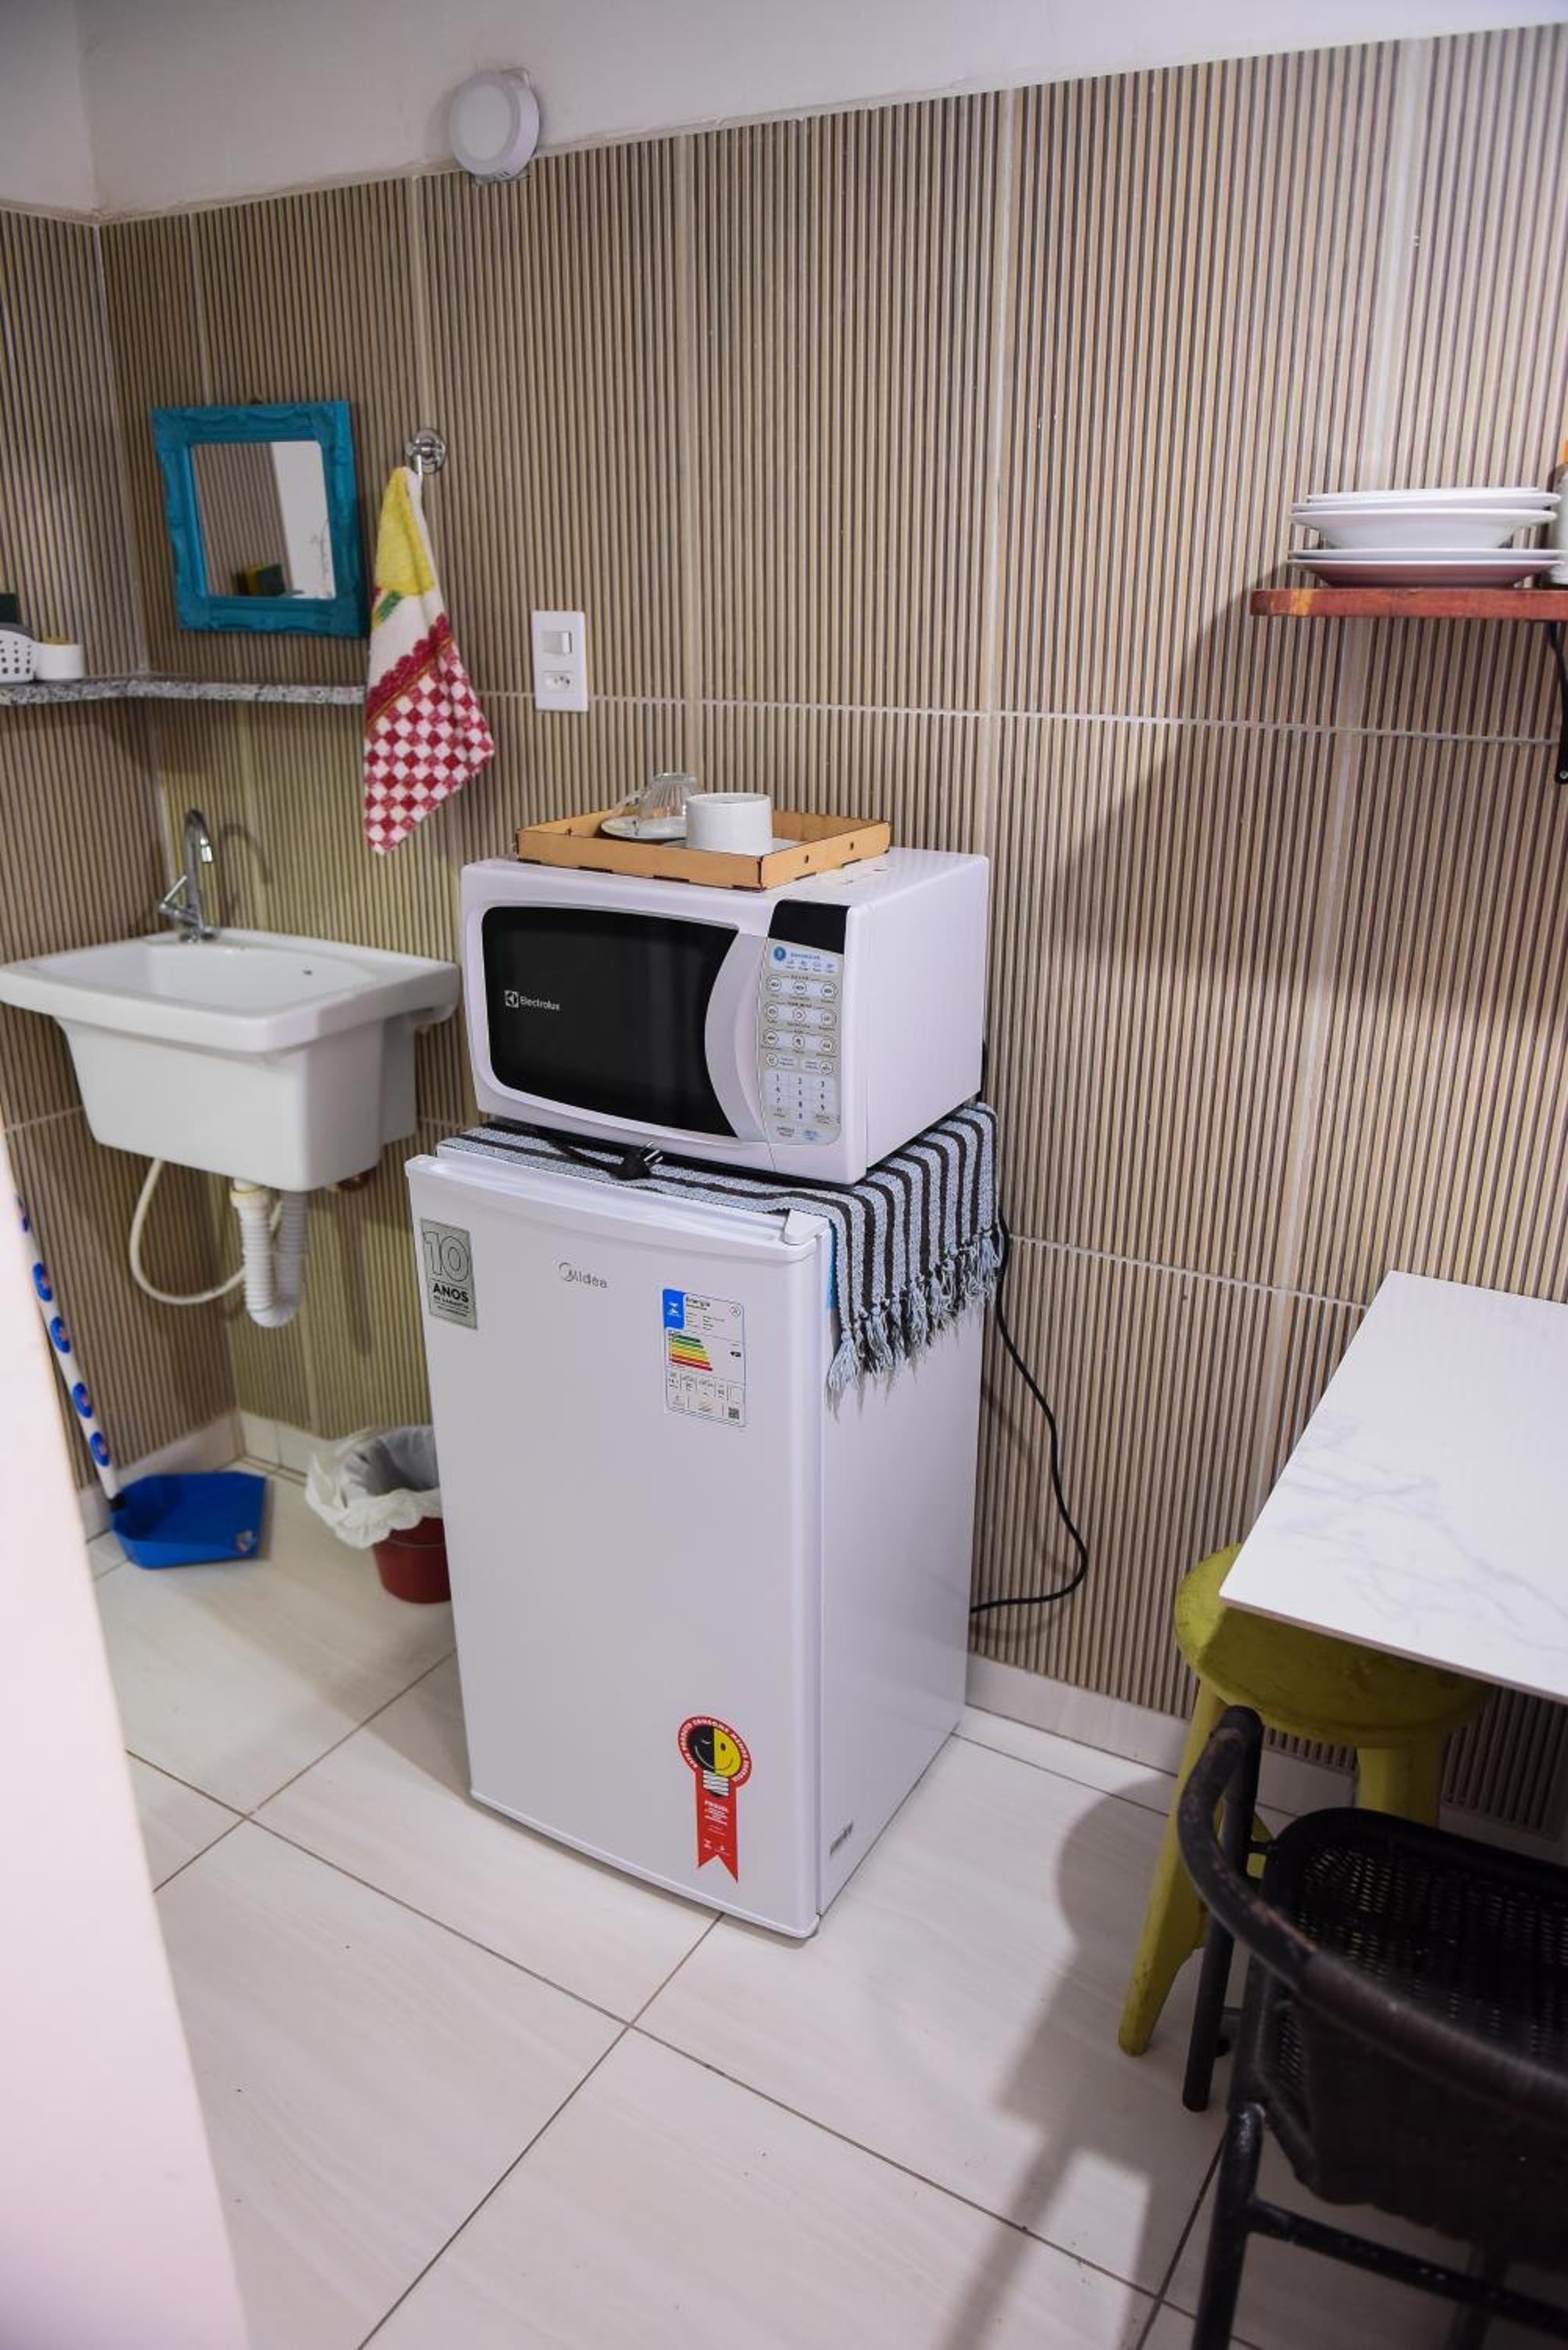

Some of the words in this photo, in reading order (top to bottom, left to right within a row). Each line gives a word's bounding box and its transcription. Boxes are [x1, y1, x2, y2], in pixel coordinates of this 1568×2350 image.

[519, 996, 560, 1010] Electrolux
[423, 1231, 469, 1282] 10
[559, 1263, 607, 1289] Midea
[433, 1282, 469, 1303] ANOS
